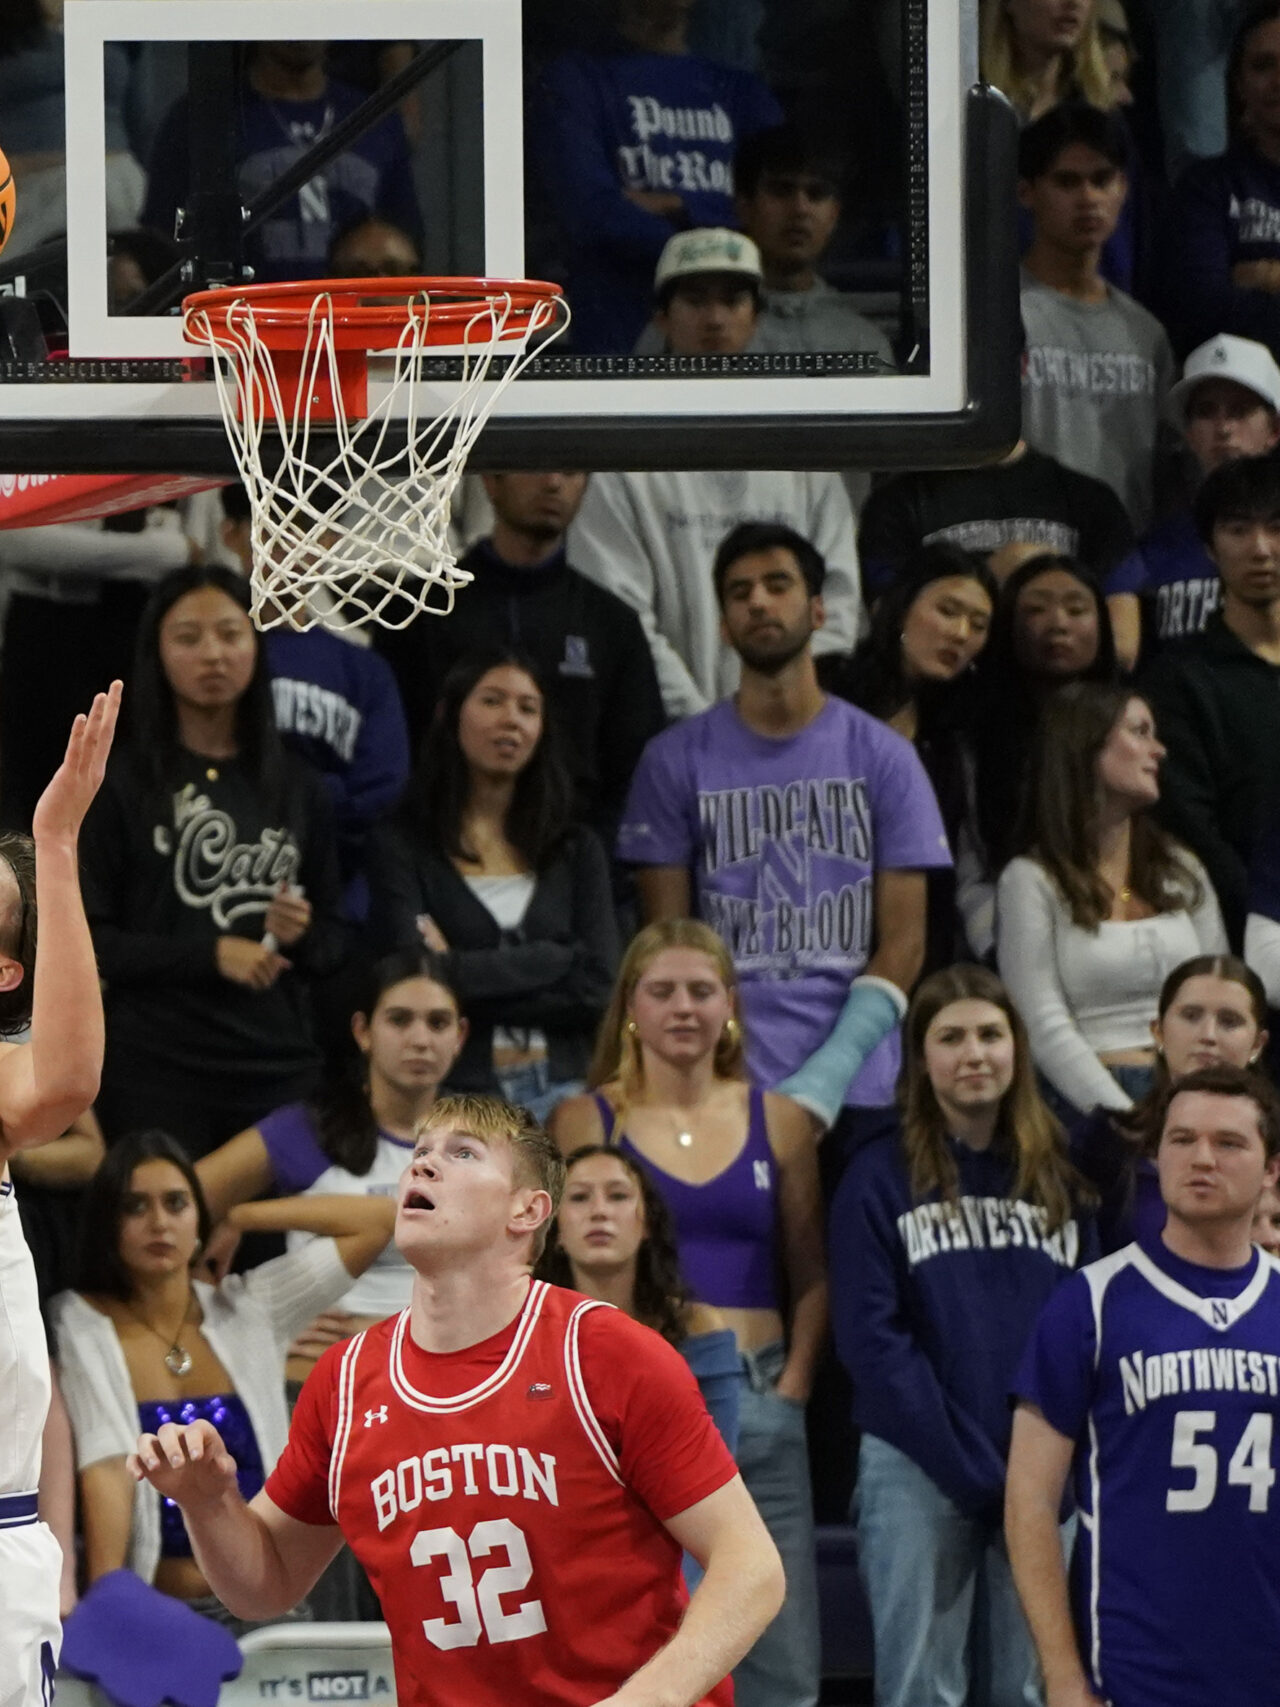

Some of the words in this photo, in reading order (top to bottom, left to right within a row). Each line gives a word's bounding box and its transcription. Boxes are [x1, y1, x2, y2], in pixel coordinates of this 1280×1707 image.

[627, 95, 734, 143] Pound
[753, 1159, 771, 1190] N
[1211, 1301, 1229, 1326] N
[1119, 1349, 1280, 1417] NORTHWEST
[370, 1443, 559, 1533] BOSTON
[1166, 1410, 1276, 1513] 54
[409, 1518, 548, 1651] 32
[259, 1676, 303, 1698] IT'S
[310, 1676, 365, 1698] NOT
[373, 1675, 390, 1694] A
